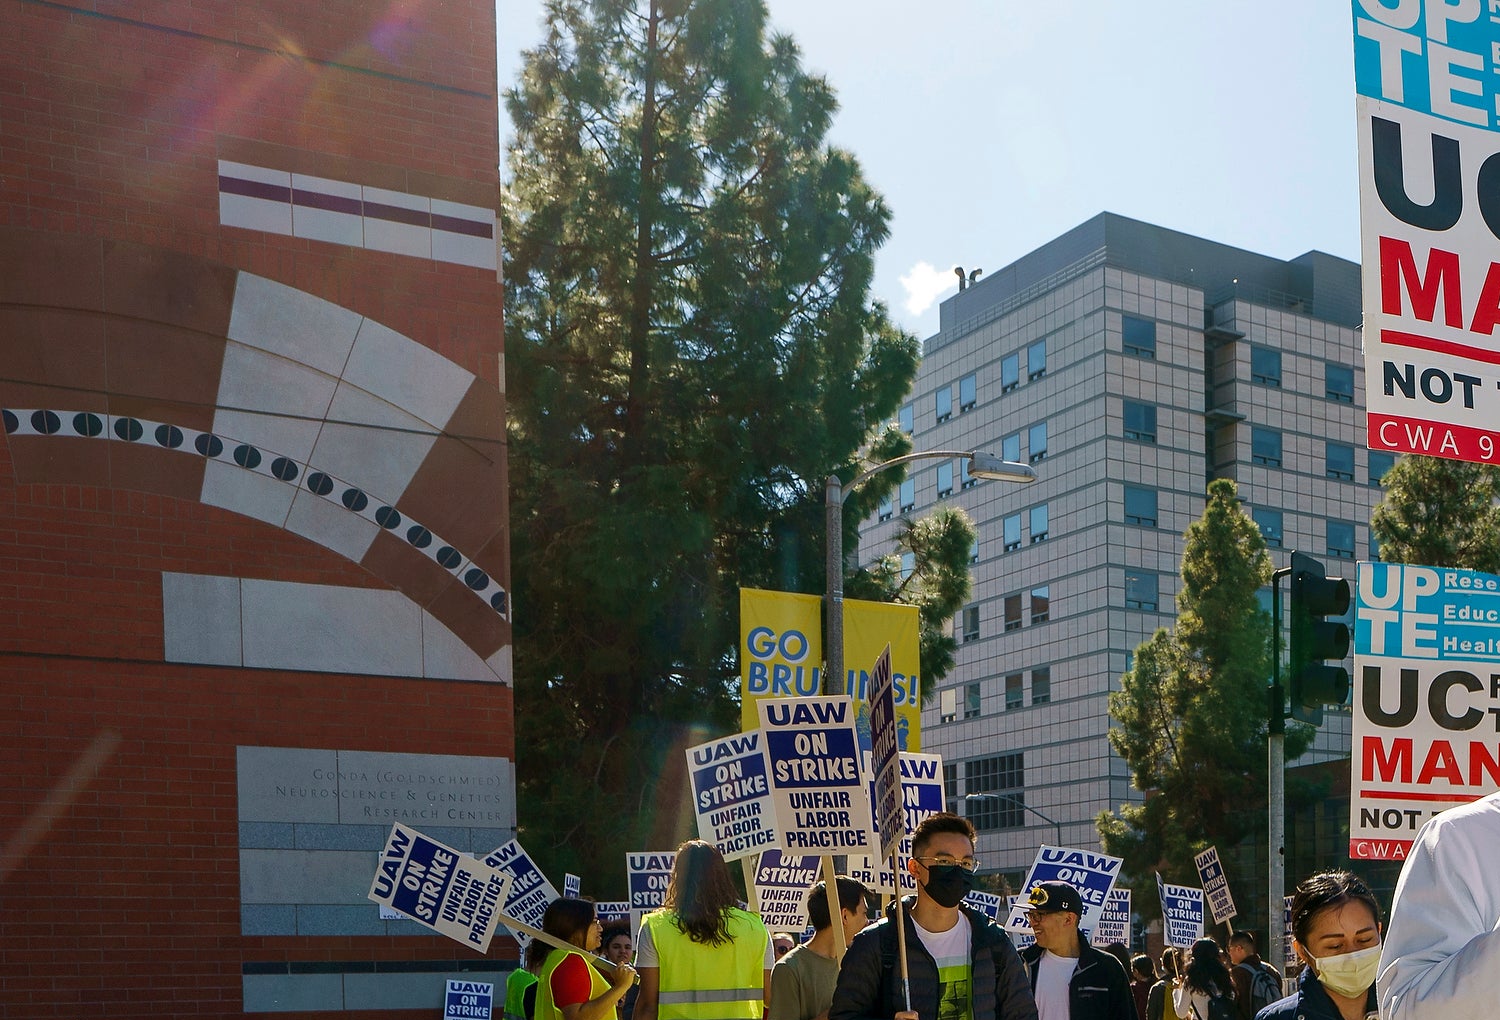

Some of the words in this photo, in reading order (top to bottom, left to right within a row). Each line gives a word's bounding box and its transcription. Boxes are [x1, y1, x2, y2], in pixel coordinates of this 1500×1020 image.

[1357, 17, 1488, 127] TE
[1383, 361, 1482, 410] NOT
[1379, 420, 1460, 456] CWA
[1358, 564, 1440, 612] UP
[1358, 607, 1439, 659] TE
[747, 626, 809, 664] GO
[1361, 665, 1485, 731] UC
[766, 702, 847, 727] UAW
[694, 734, 759, 767] UAW
[794, 731, 828, 756] ON
[715, 759, 743, 784] ON
[775, 757, 857, 783] STRIKE
[406, 790, 416, 801] &
[699, 775, 766, 809] STRIKE
[789, 791, 851, 810] UNFAIR
[710, 802, 762, 827] UNFAIR
[796, 811, 851, 829] LABOR
[1360, 808, 1421, 830] NOT
[715, 818, 761, 842] LABOR
[785, 829, 868, 848] PRACTICE
[718, 829, 775, 856] RACTICE
[1357, 842, 1404, 858] CWA
[374, 829, 411, 898] UAW
[485, 842, 518, 868] AW
[1041, 850, 1119, 873] UAW
[1196, 849, 1216, 868] UAW
[402, 859, 428, 891] ON
[759, 867, 816, 885] STRIKE
[1057, 868, 1088, 884] ON
[1206, 866, 1216, 879] ON
[416, 849, 454, 920] STRIKE
[507, 870, 541, 900] RIKE
[1168, 887, 1202, 900] UAW
[1204, 875, 1225, 893] STRIKE
[442, 868, 472, 923] UNFAIR
[457, 879, 486, 928] LABOR
[507, 890, 547, 918] UNFAIR
[761, 889, 803, 901] UNFAIR
[966, 893, 999, 905] UAW
[1177, 899, 1192, 910] ON
[469, 873, 505, 945] PRACTICE
[597, 904, 630, 912] UAW
[760, 902, 798, 913] LABOR
[1101, 911, 1128, 922] TRIKE
[1106, 902, 1119, 911] ON
[1168, 909, 1202, 921] STRIKE
[762, 914, 804, 926] RACTICE
[1099, 922, 1125, 930] UNFAIR
[1171, 921, 1198, 931] UNFAIR
[1094, 937, 1128, 945] PRACTICE
[1172, 929, 1197, 938] LABOR
[450, 981, 490, 994] UAW
[461, 995, 477, 1006] ON
[448, 1005, 489, 1017] STRIKE
